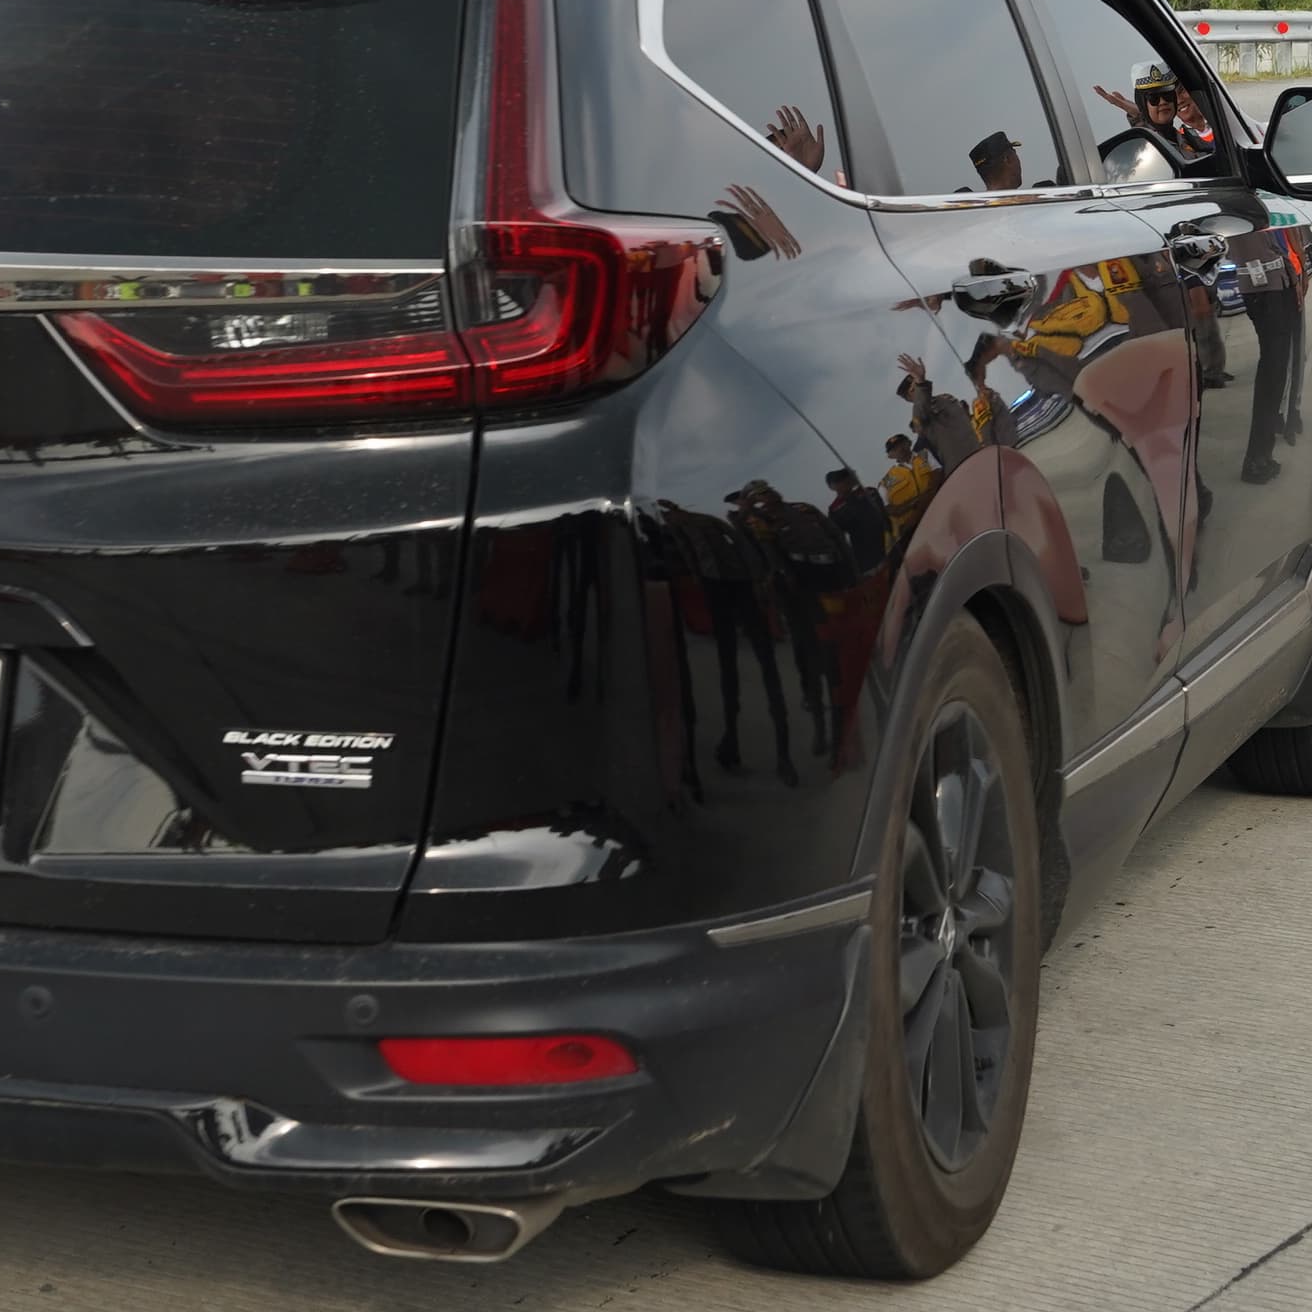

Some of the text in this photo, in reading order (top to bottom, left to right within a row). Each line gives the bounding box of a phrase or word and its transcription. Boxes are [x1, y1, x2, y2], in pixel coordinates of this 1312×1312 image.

[222, 731, 394, 749] BLACK EDITION
[241, 752, 373, 774] VTEC
